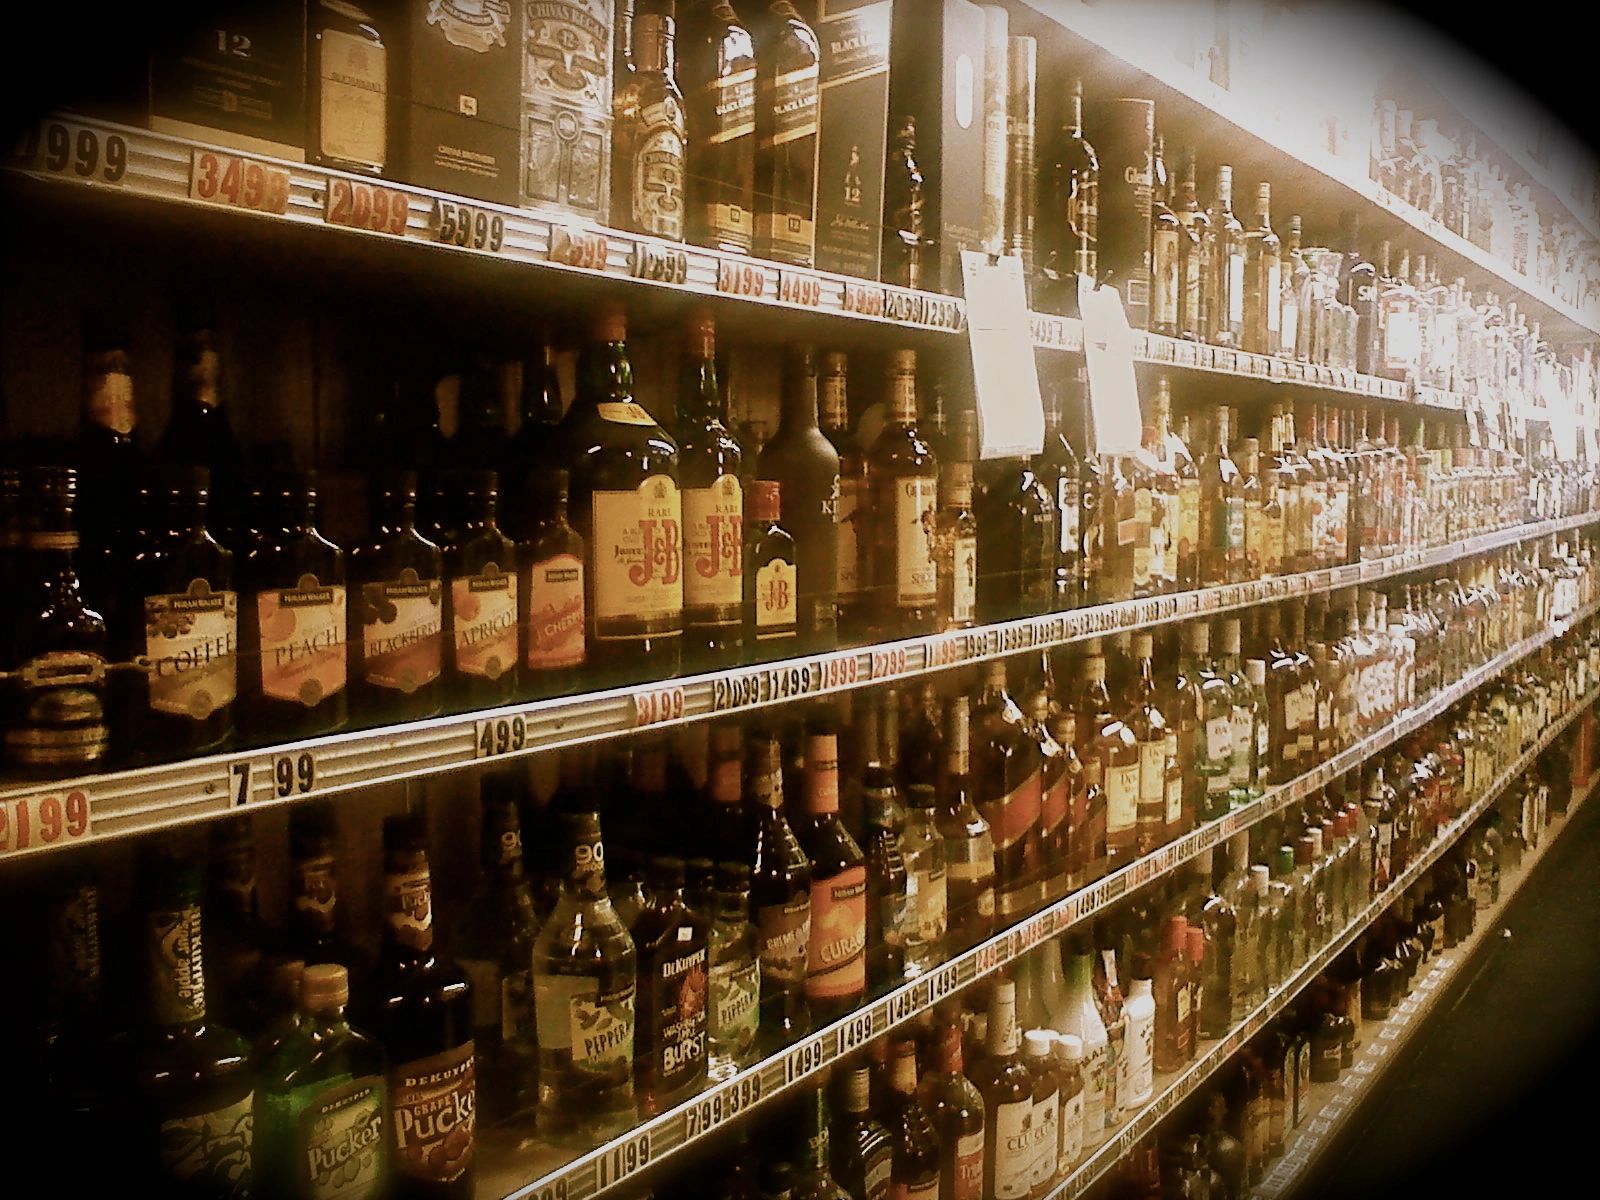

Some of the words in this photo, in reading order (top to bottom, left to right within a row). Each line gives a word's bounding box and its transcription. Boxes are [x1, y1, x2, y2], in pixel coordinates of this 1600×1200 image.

[529, 2, 568, 19] CHIVAS
[215, 30, 251, 57] 12
[28, 120, 127, 182] 999
[440, 204, 504, 252] 5999
[721, 261, 764, 297] 3199
[629, 519, 680, 587] J&B
[158, 632, 235, 676] COFFEE
[275, 625, 340, 666] PEACH
[370, 620, 440, 656] BLACKBERRY
[233, 763, 250, 805] 7
[276, 752, 315, 797] 99
[480, 715, 525, 758] 499
[771, 667, 811, 700] 1499
[823, 656, 856, 689] 1999
[576, 841, 604, 865] 90
[174, 957, 192, 998] apple
[664, 1031, 706, 1072] BURST
[601, 1136, 649, 1188] 1199
[688, 1096, 722, 1138] 799
[731, 1074, 761, 1113] 399
[840, 1015, 872, 1053] 1499
[930, 967, 958, 1002] 1499
[308, 1115, 382, 1181] Pucker
